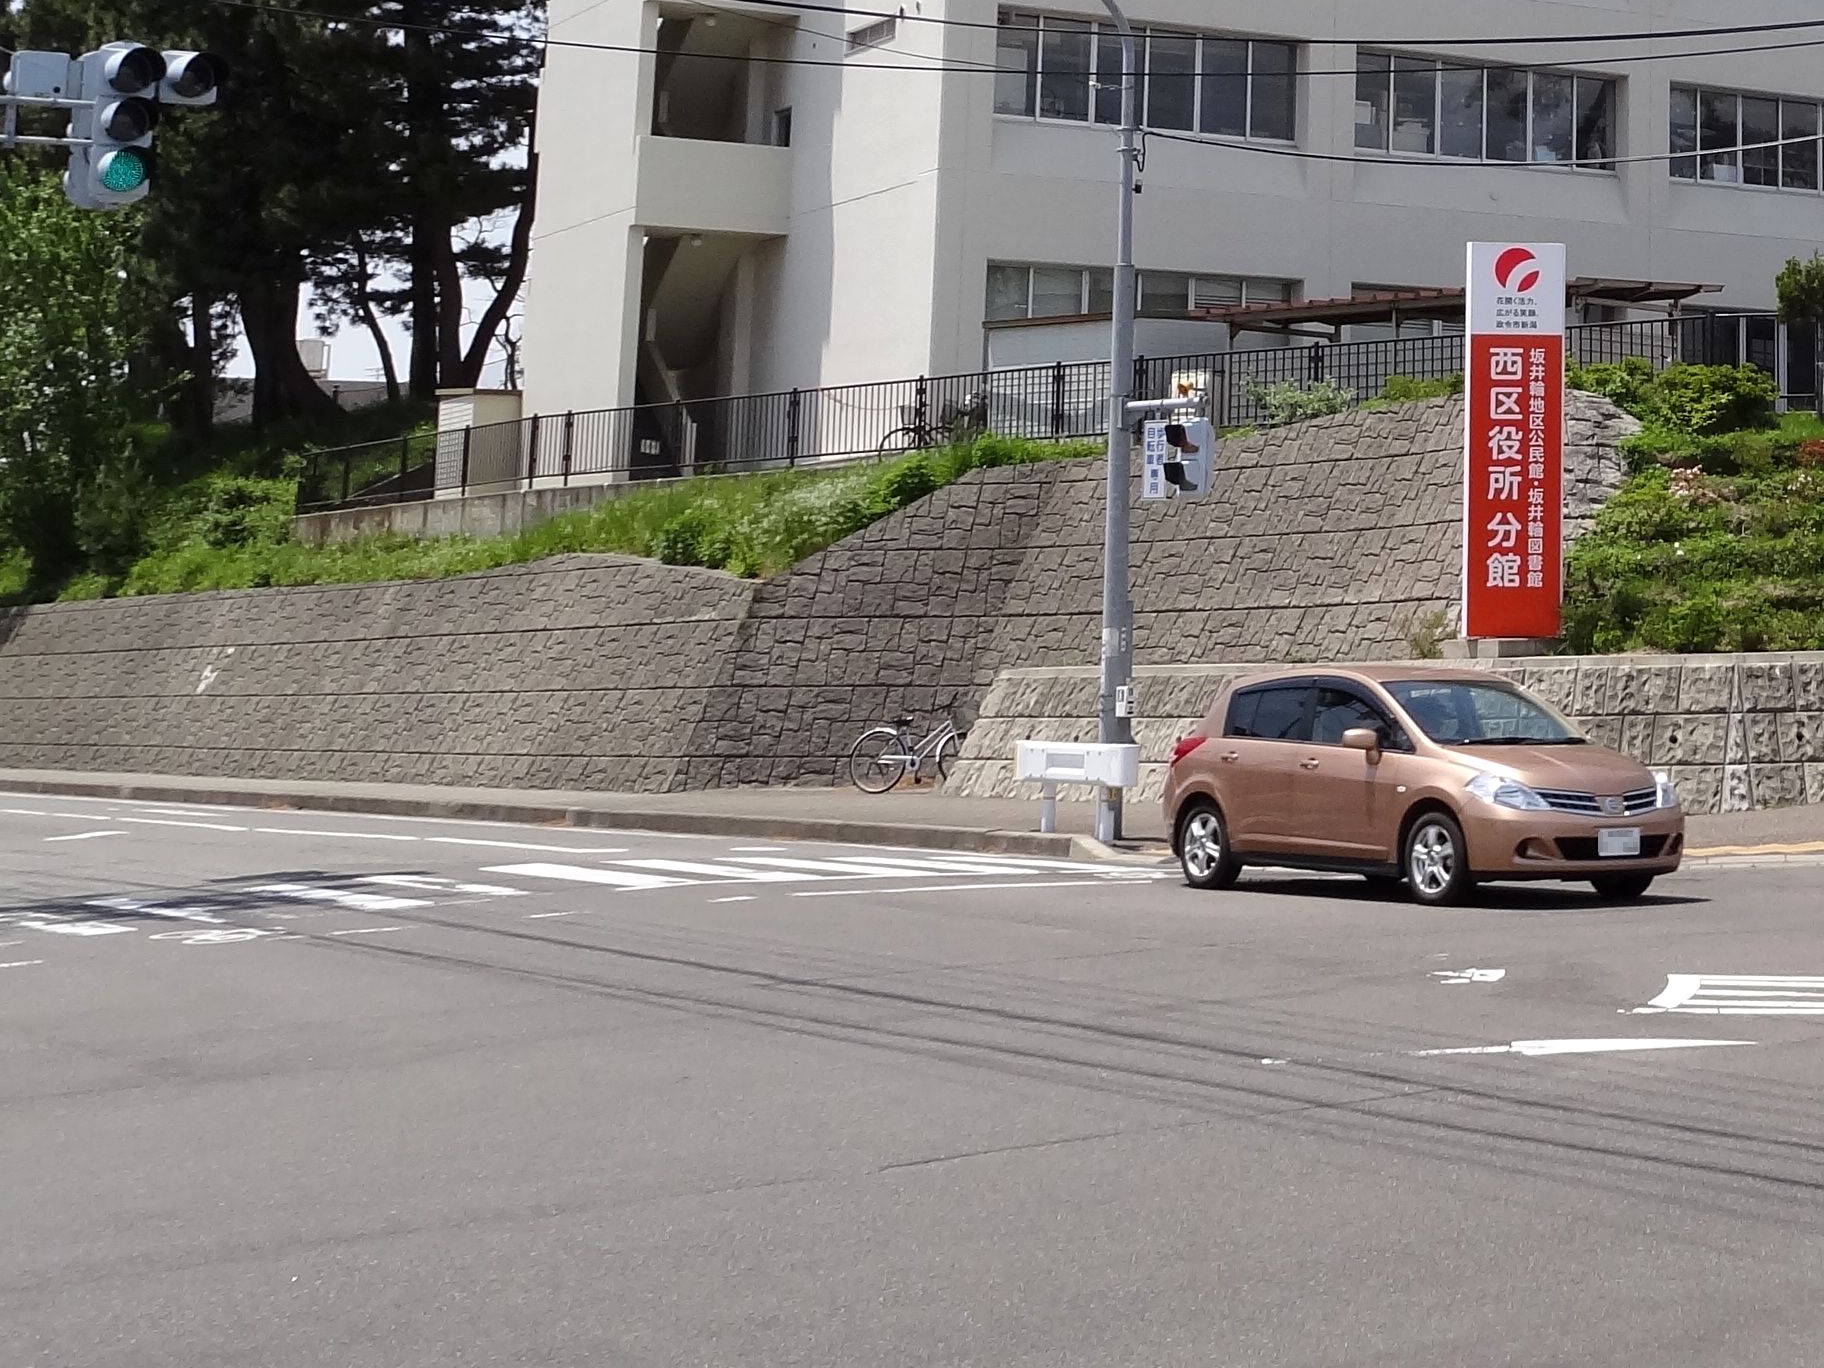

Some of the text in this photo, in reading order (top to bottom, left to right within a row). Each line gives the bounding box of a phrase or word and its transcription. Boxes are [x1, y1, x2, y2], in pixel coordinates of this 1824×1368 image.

[1527, 348, 1546, 588] 坂井輪地区公民館・坂井輪図書館
